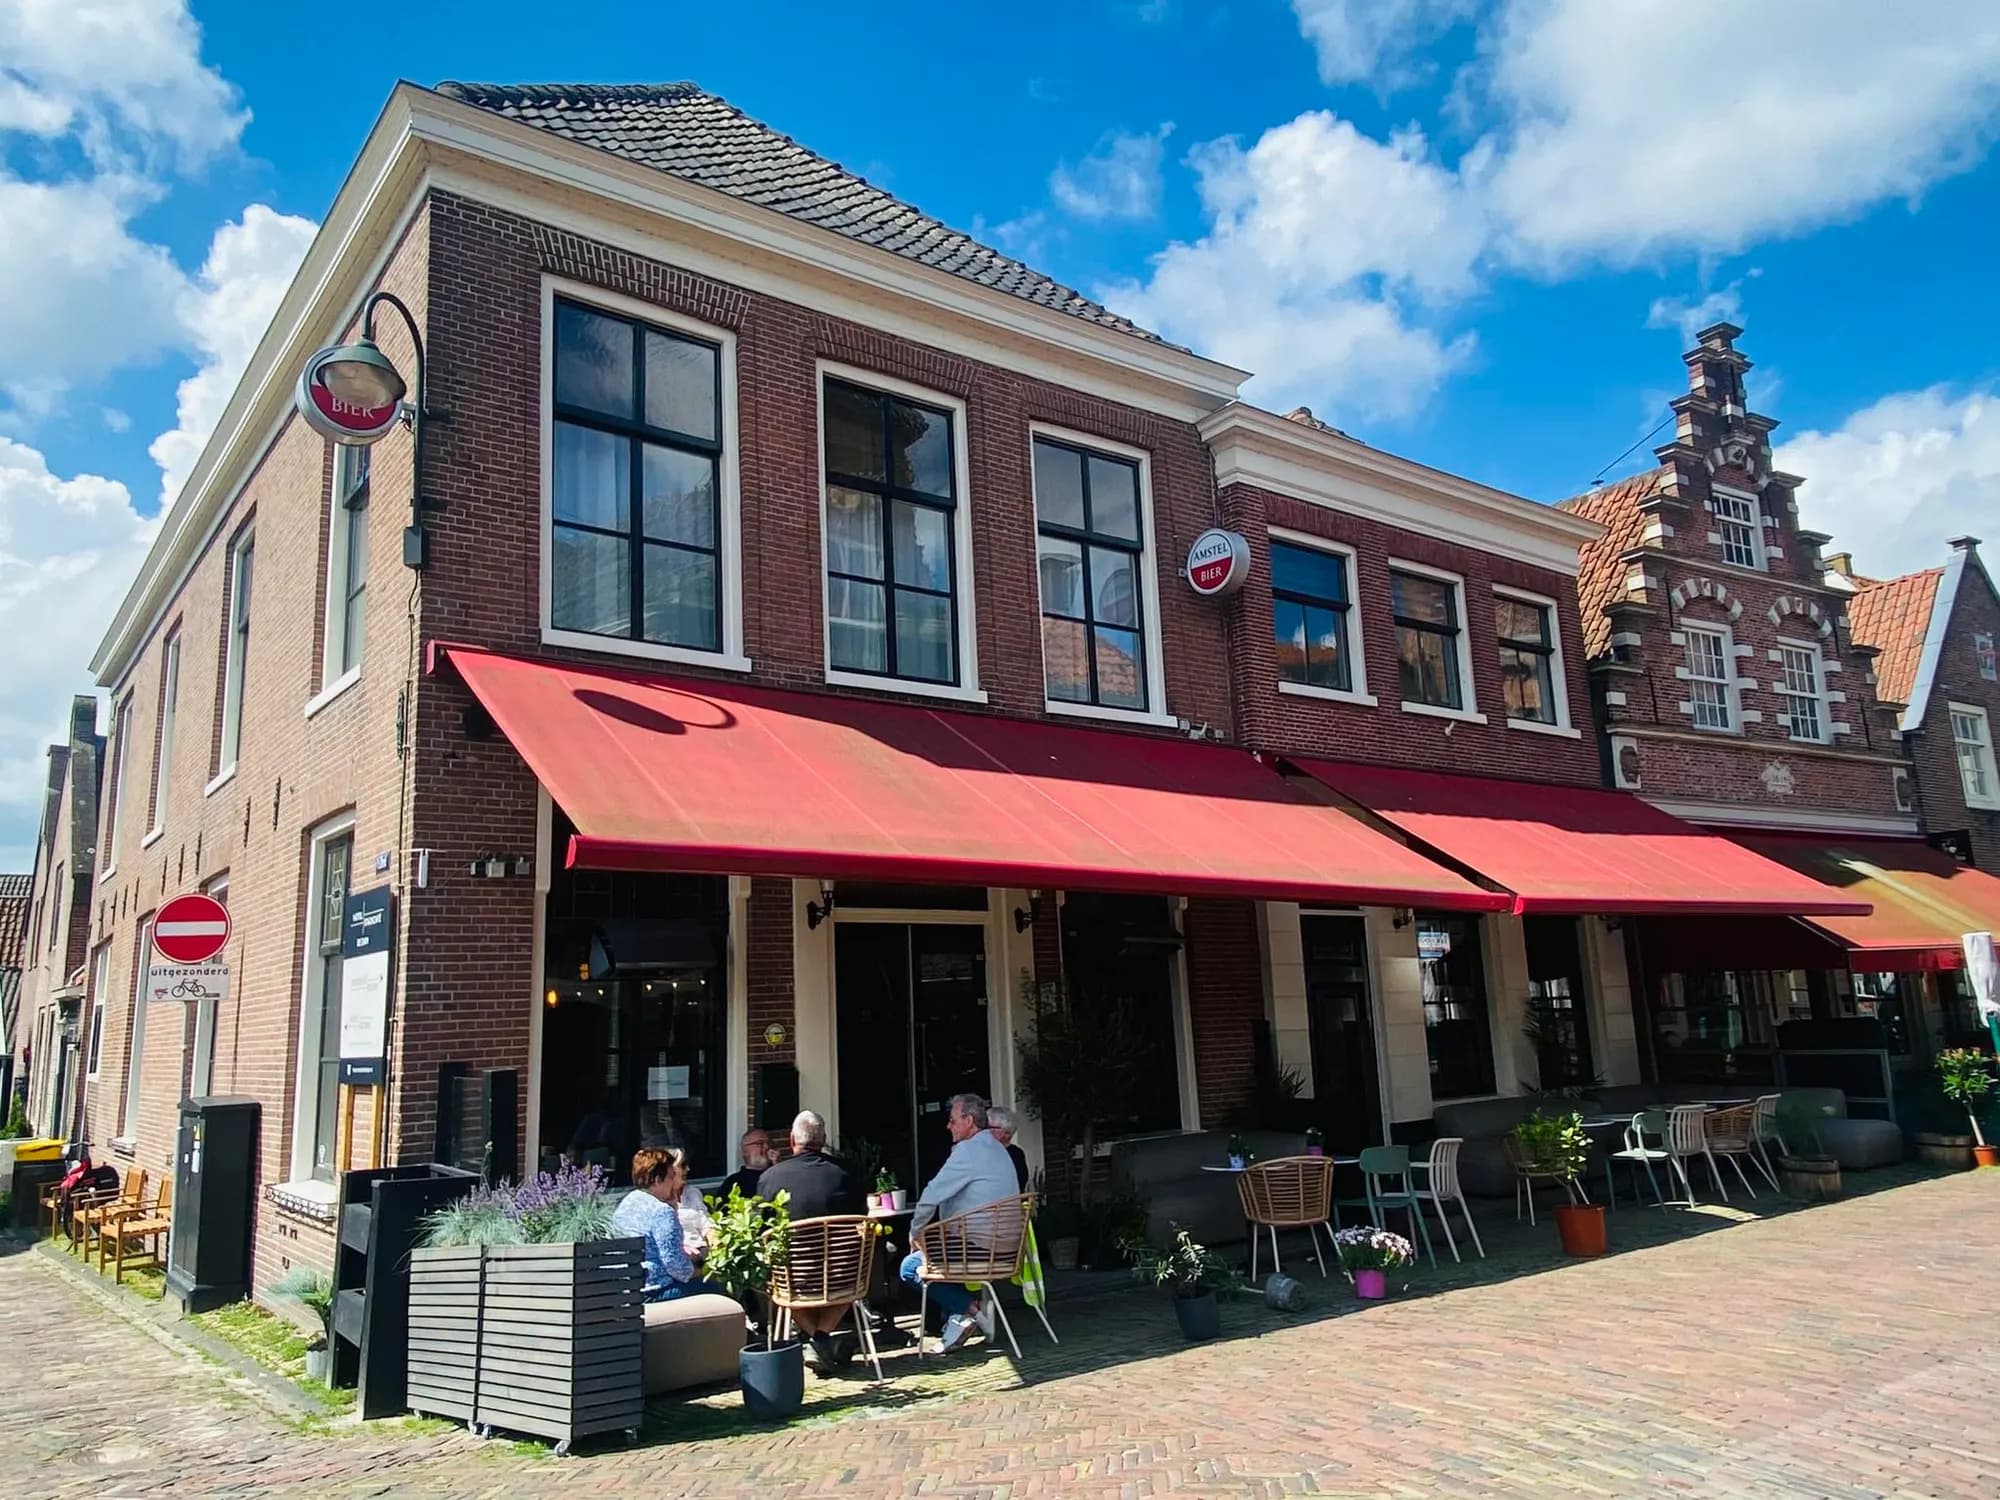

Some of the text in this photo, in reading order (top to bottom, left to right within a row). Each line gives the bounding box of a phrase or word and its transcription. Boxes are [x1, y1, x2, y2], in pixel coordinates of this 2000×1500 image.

[332, 397, 374, 419] BIER
[1194, 542, 1228, 562] AMSTEL
[1201, 566, 1222, 582] BIER
[151, 967, 229, 978] uitgezonderd
